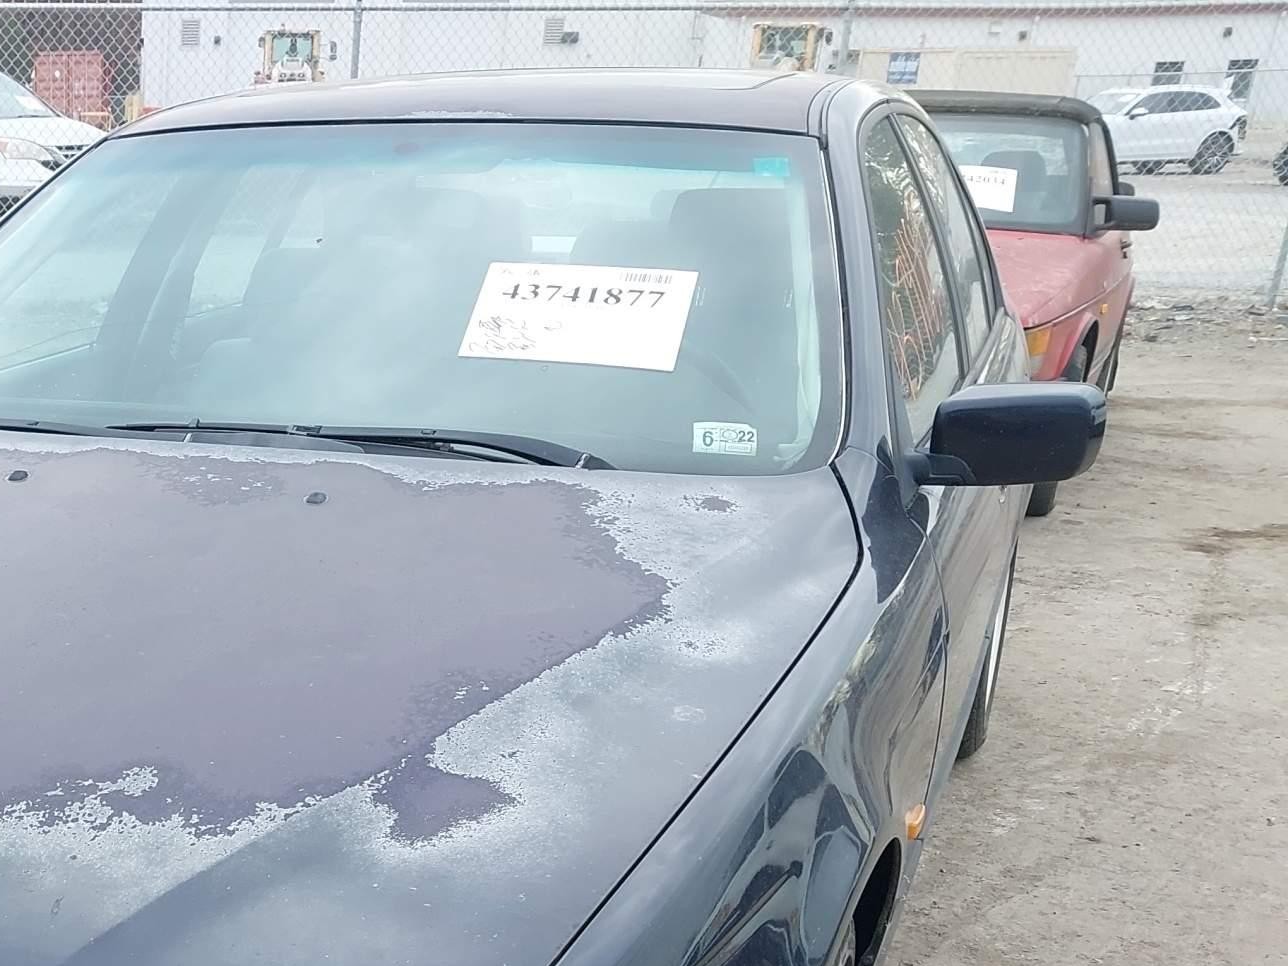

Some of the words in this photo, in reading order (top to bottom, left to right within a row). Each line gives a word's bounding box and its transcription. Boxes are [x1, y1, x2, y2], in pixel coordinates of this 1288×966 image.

[502, 283, 666, 308] 43741877
[702, 430, 714, 447] 6
[738, 430, 755, 443] 22
